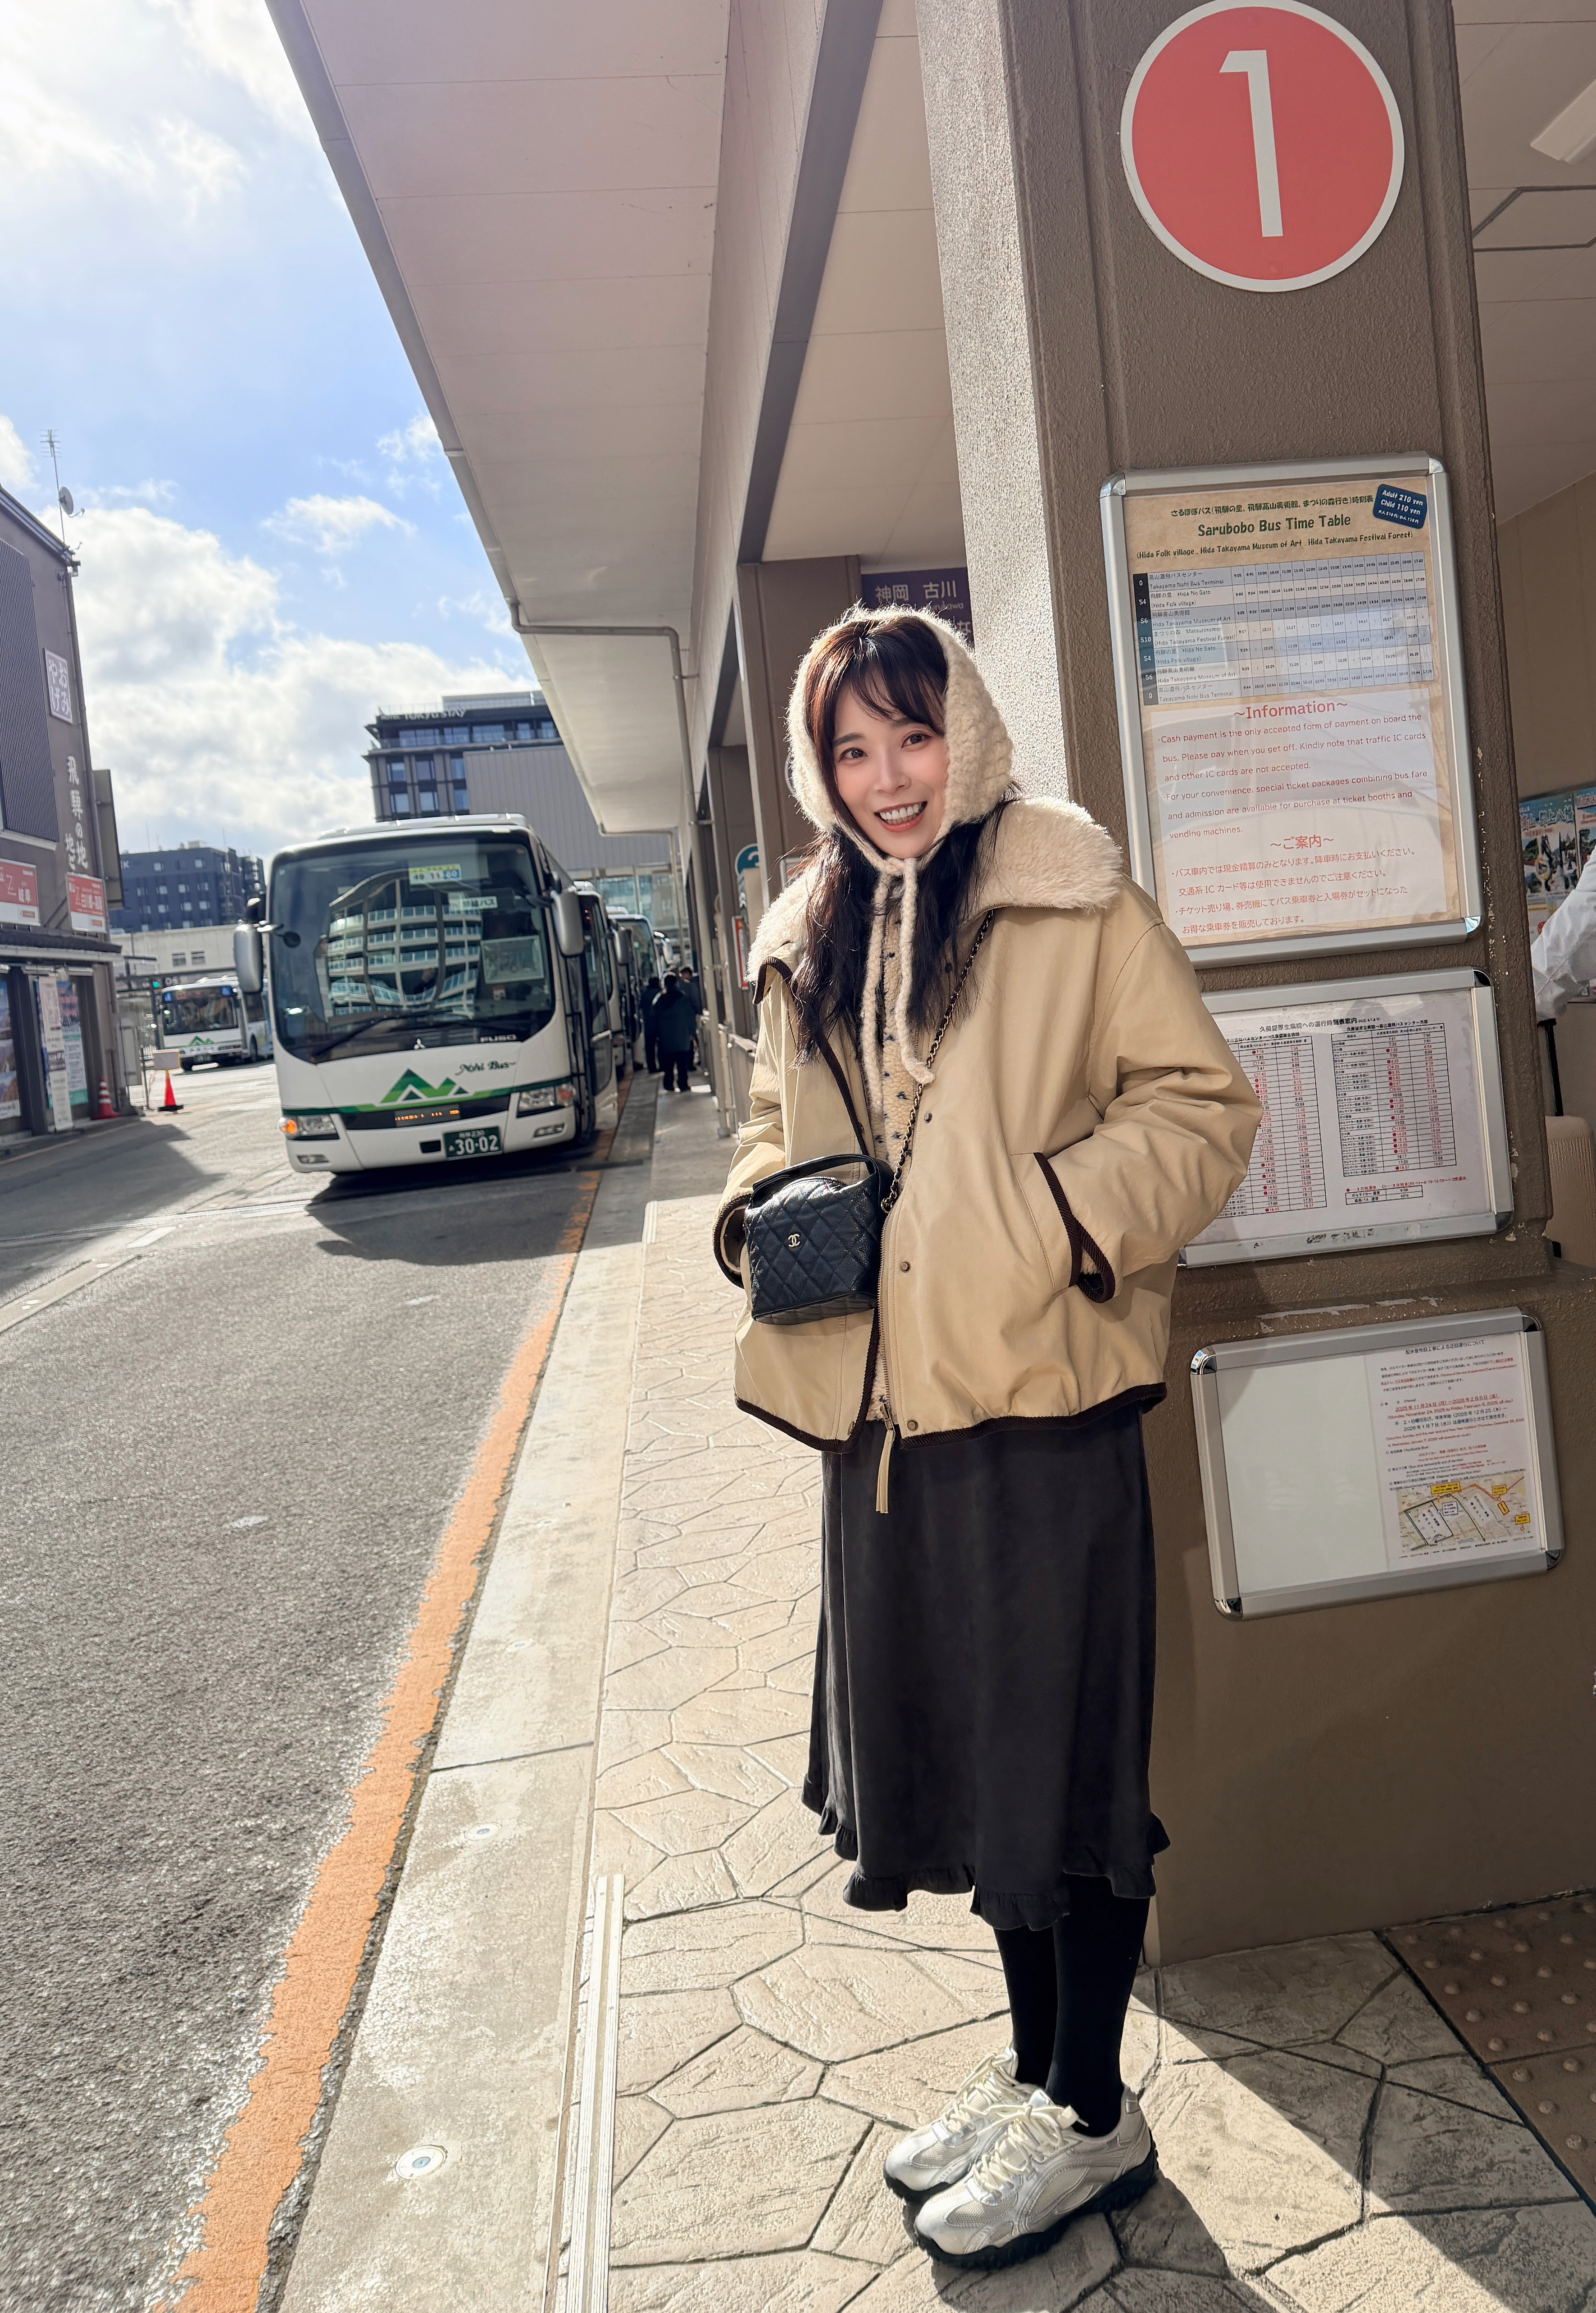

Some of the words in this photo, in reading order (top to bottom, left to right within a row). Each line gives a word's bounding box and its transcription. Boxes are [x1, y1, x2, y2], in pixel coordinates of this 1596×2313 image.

[1219, 50, 1283, 237] 1
[1381, 499, 1395, 508] Child
[1397, 504, 1409, 512] 110
[1382, 490, 1397, 499] Adult
[1399, 494, 1411, 503] 210
[1198, 522, 1255, 536] Sarubobo
[1260, 519, 1281, 532] Bus
[1286, 518, 1314, 530] Time
[1319, 514, 1350, 527] Table
[1360, 533, 1386, 541] Festival
[1388, 531, 1413, 540] Forest)
[875, 584, 909, 601] 神岡
[923, 580, 957, 599] 古川
[1161, 735, 1181, 743] Cash
[1183, 732, 1218, 743] payment
[1245, 728, 1261, 736] only
[1264, 724, 1300, 734] accepted
[1335, 718, 1369, 729] payment
[1384, 714, 1405, 723] board
[1211, 752, 1225, 760] pay
[1251, 748, 1265, 756] you
[1268, 745, 1281, 754] get
[1300, 741, 1324, 750] Kindly
[1327, 740, 1345, 748] note
[1347, 737, 1363, 745] that
[1366, 736, 1390, 744] traffic
[1405, 732, 1426, 741] cards
[1164, 774, 1179, 782] and
[1217, 768, 1238, 777] cards
[1256, 765, 1269, 773] not
[1271, 762, 1310, 772] accepted.
[1181, 792, 1199, 800] your
[1201, 787, 1253, 797] convenience,
[1256, 783, 1284, 794] special
[1287, 781, 1310, 789] ticket
[1312, 779, 1349, 789] packages
[1352, 774, 1392, 783] combining
[1168, 812, 1182, 820] and
[1185, 809, 1224, 818] admission
[1242, 804, 1277, 813] available
[1294, 800, 1330, 810] purchase
[1343, 795, 1366, 804] ticket
[1368, 793, 1395, 801] booths
[1170, 830, 1200, 839] vending
[1204, 827, 1242, 836] machines.
[1178, 886, 1203, 897] 交通系
[1205, 885, 1215, 894] IC
[455, 1062, 484, 1076] Nohi
[487, 1060, 516, 1069] Bus
